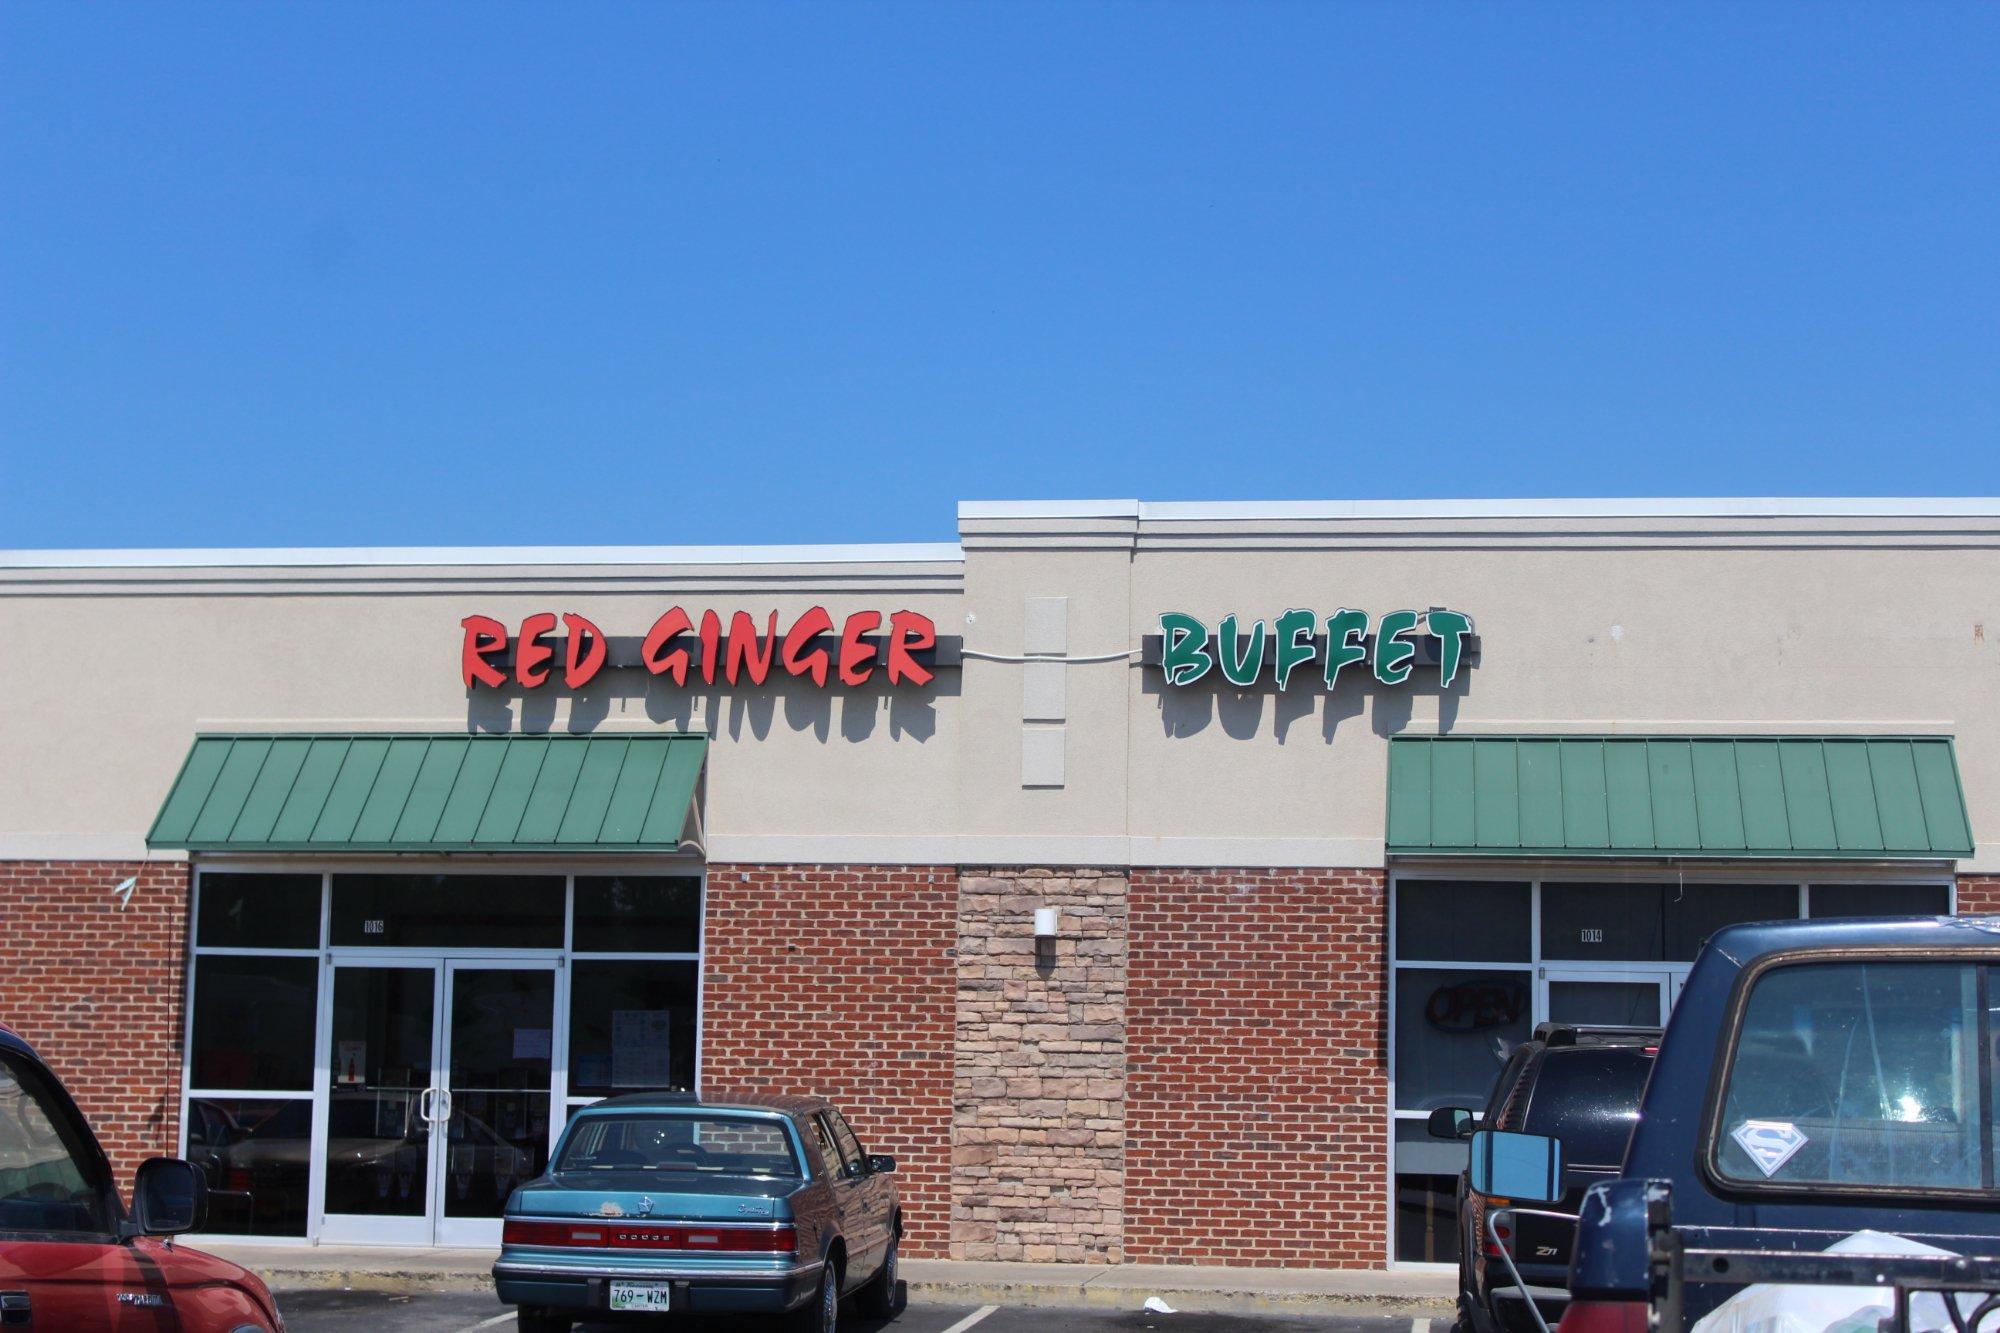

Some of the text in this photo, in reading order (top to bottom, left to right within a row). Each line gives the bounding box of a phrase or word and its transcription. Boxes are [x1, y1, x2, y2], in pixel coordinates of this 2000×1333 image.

[461, 605, 936, 689] RED GINGER
[1158, 607, 1473, 692] BUFFET
[364, 920, 384, 933] 1016
[1582, 929, 1603, 942] 1014
[1427, 984, 1523, 1026] OPEN
